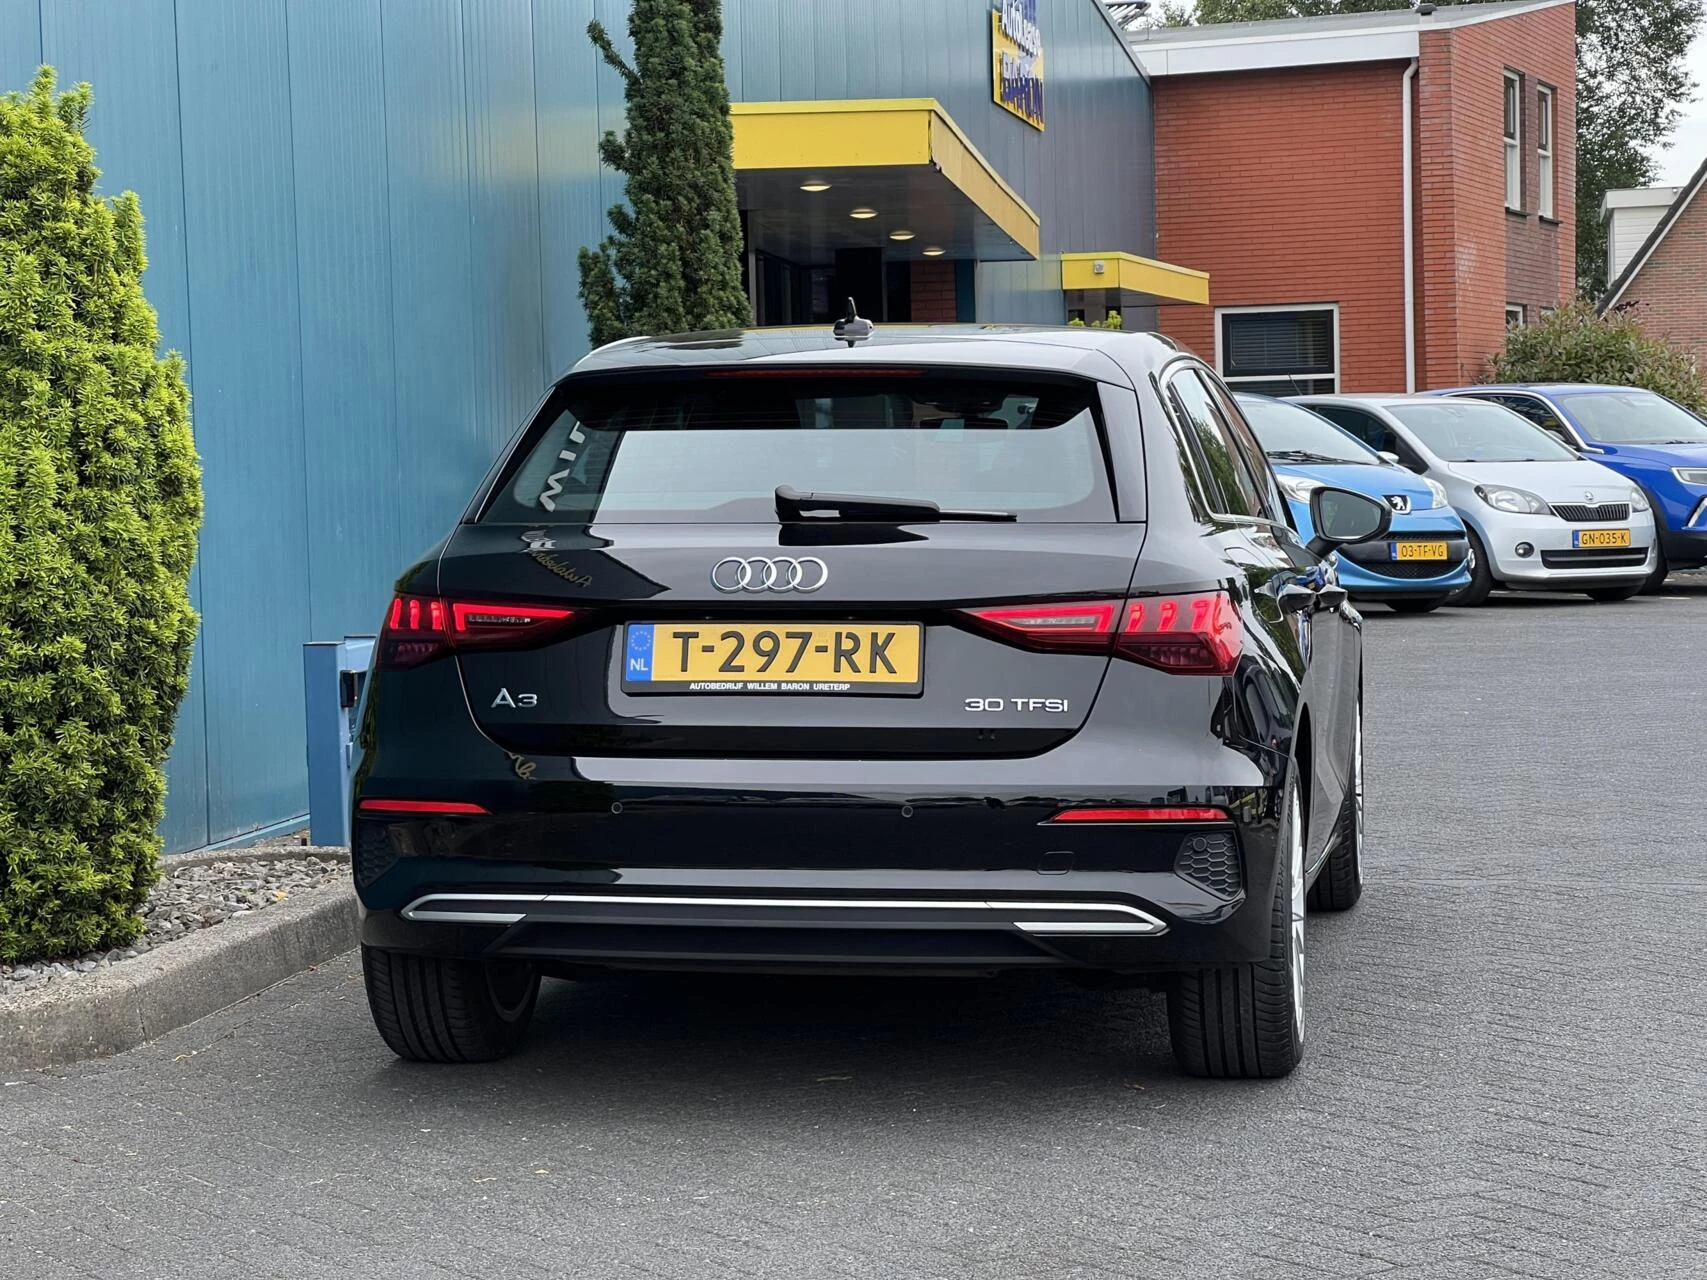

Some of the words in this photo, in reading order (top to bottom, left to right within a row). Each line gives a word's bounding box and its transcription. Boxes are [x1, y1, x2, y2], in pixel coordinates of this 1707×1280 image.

[1581, 532, 1627, 545] GN-035-K
[1401, 544, 1444, 557] 03-TF-VG
[672, 630, 897, 674] T-297-RK
[630, 658, 648, 671] NL
[689, 682, 744, 690] AUTOBEDRIJF
[747, 682, 777, 690] WILLEM
[781, 682, 809, 690] BARON
[813, 682, 850, 691] URETERP
[491, 687, 538, 708] A3
[964, 698, 1004, 711] 30
[1010, 698, 1069, 712] TFSI
